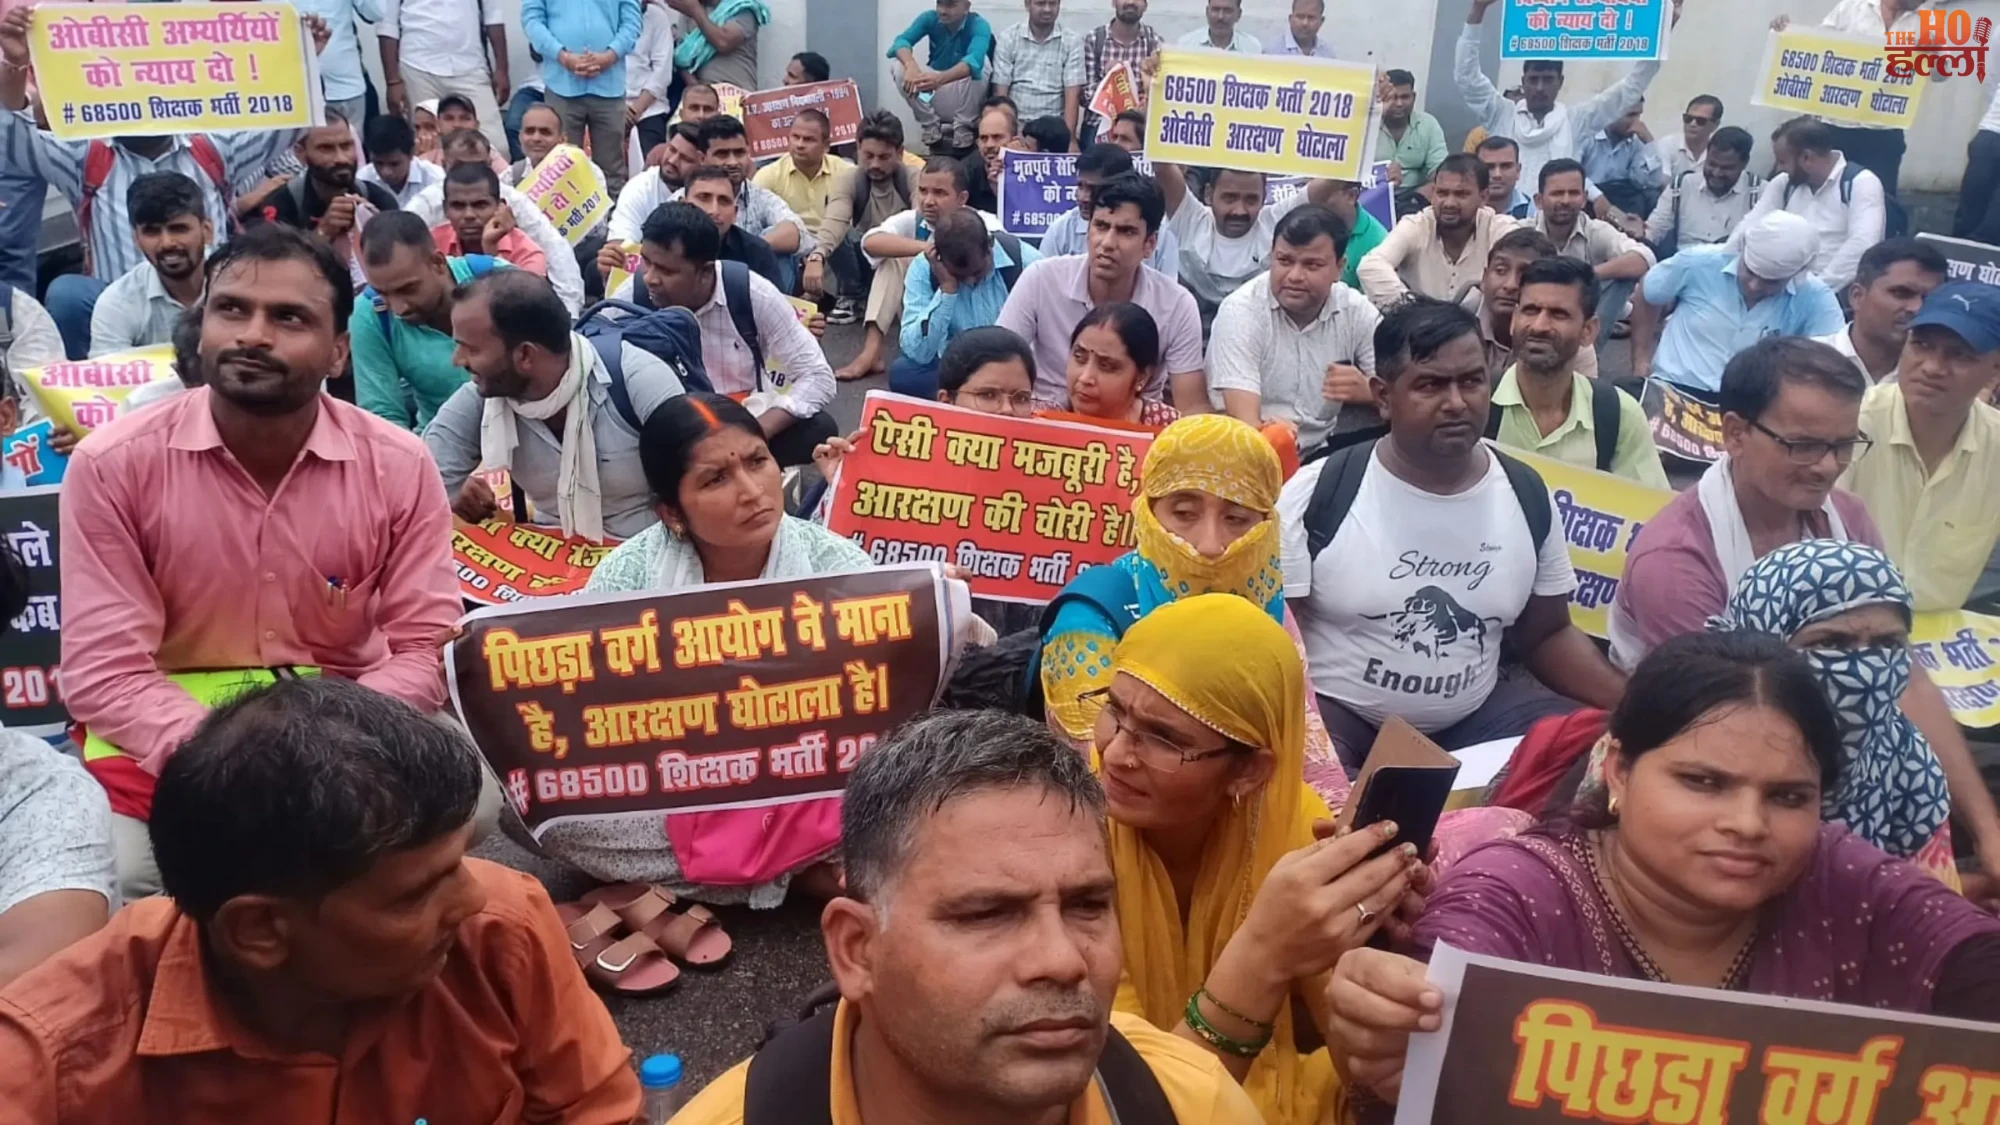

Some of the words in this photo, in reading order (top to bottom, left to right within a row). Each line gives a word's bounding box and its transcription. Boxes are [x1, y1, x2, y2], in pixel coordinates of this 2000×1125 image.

[47, 14, 149, 50] ओबीसी
[80, 55, 122, 88] को
[130, 59, 196, 84] न्याय
[204, 51, 235, 83] दो
[249, 53, 259, 81] !
[1781, 49, 1818, 72] 68500
[1821, 50, 1858, 77] शिक्षक
[63, 102, 75, 124] #
[81, 102, 142, 123] 68500
[149, 95, 203, 119] शिक्षक
[249, 95, 294, 114] 2018
[1164, 75, 1216, 105] 68500
[1222, 74, 1271, 111] शिक्षक
[1275, 80, 1306, 114] भर्ती
[1309, 90, 1354, 119] 2018
[1773, 72, 1813, 100] ओबीसी
[1819, 84, 1863, 108] आरक्षण
[1871, 88, 1909, 115] घोटाला
[1160, 110, 1214, 147] ओबीसी
[1226, 122, 1284, 154] आरक्षण
[1297, 123, 1348, 161] घोटाला
[1043, 181, 1062, 203] को
[1012, 211, 1021, 226] #
[71, 395, 118, 428] को
[872, 410, 938, 460] ऐसी
[946, 428, 1004, 470] क्या
[1014, 440, 1111, 494] मजबूरी
[853, 480, 975, 528] आरक्षण
[983, 492, 1027, 534] की
[1035, 498, 1094, 542] चोरी
[509, 526, 565, 561] क्या
[957, 542, 1025, 580] शिक्षक
[1028, 550, 1071, 585] भर्ती
[1389, 550, 1494, 590] Strong
[484, 628, 592, 694] पिछड़ा
[602, 610, 659, 675] वर्ग
[673, 602, 788, 667] आयोग
[793, 594, 825, 648] ने
[833, 594, 911, 645] माना
[519, 703, 568, 757] है,
[584, 692, 718, 748] आरक्षण
[727, 674, 842, 730] घोटाला
[845, 662, 888, 714] है।
[537, 762, 648, 801] 68500
[660, 748, 758, 792] शिक्षक
[768, 733, 828, 776] भर्ती
